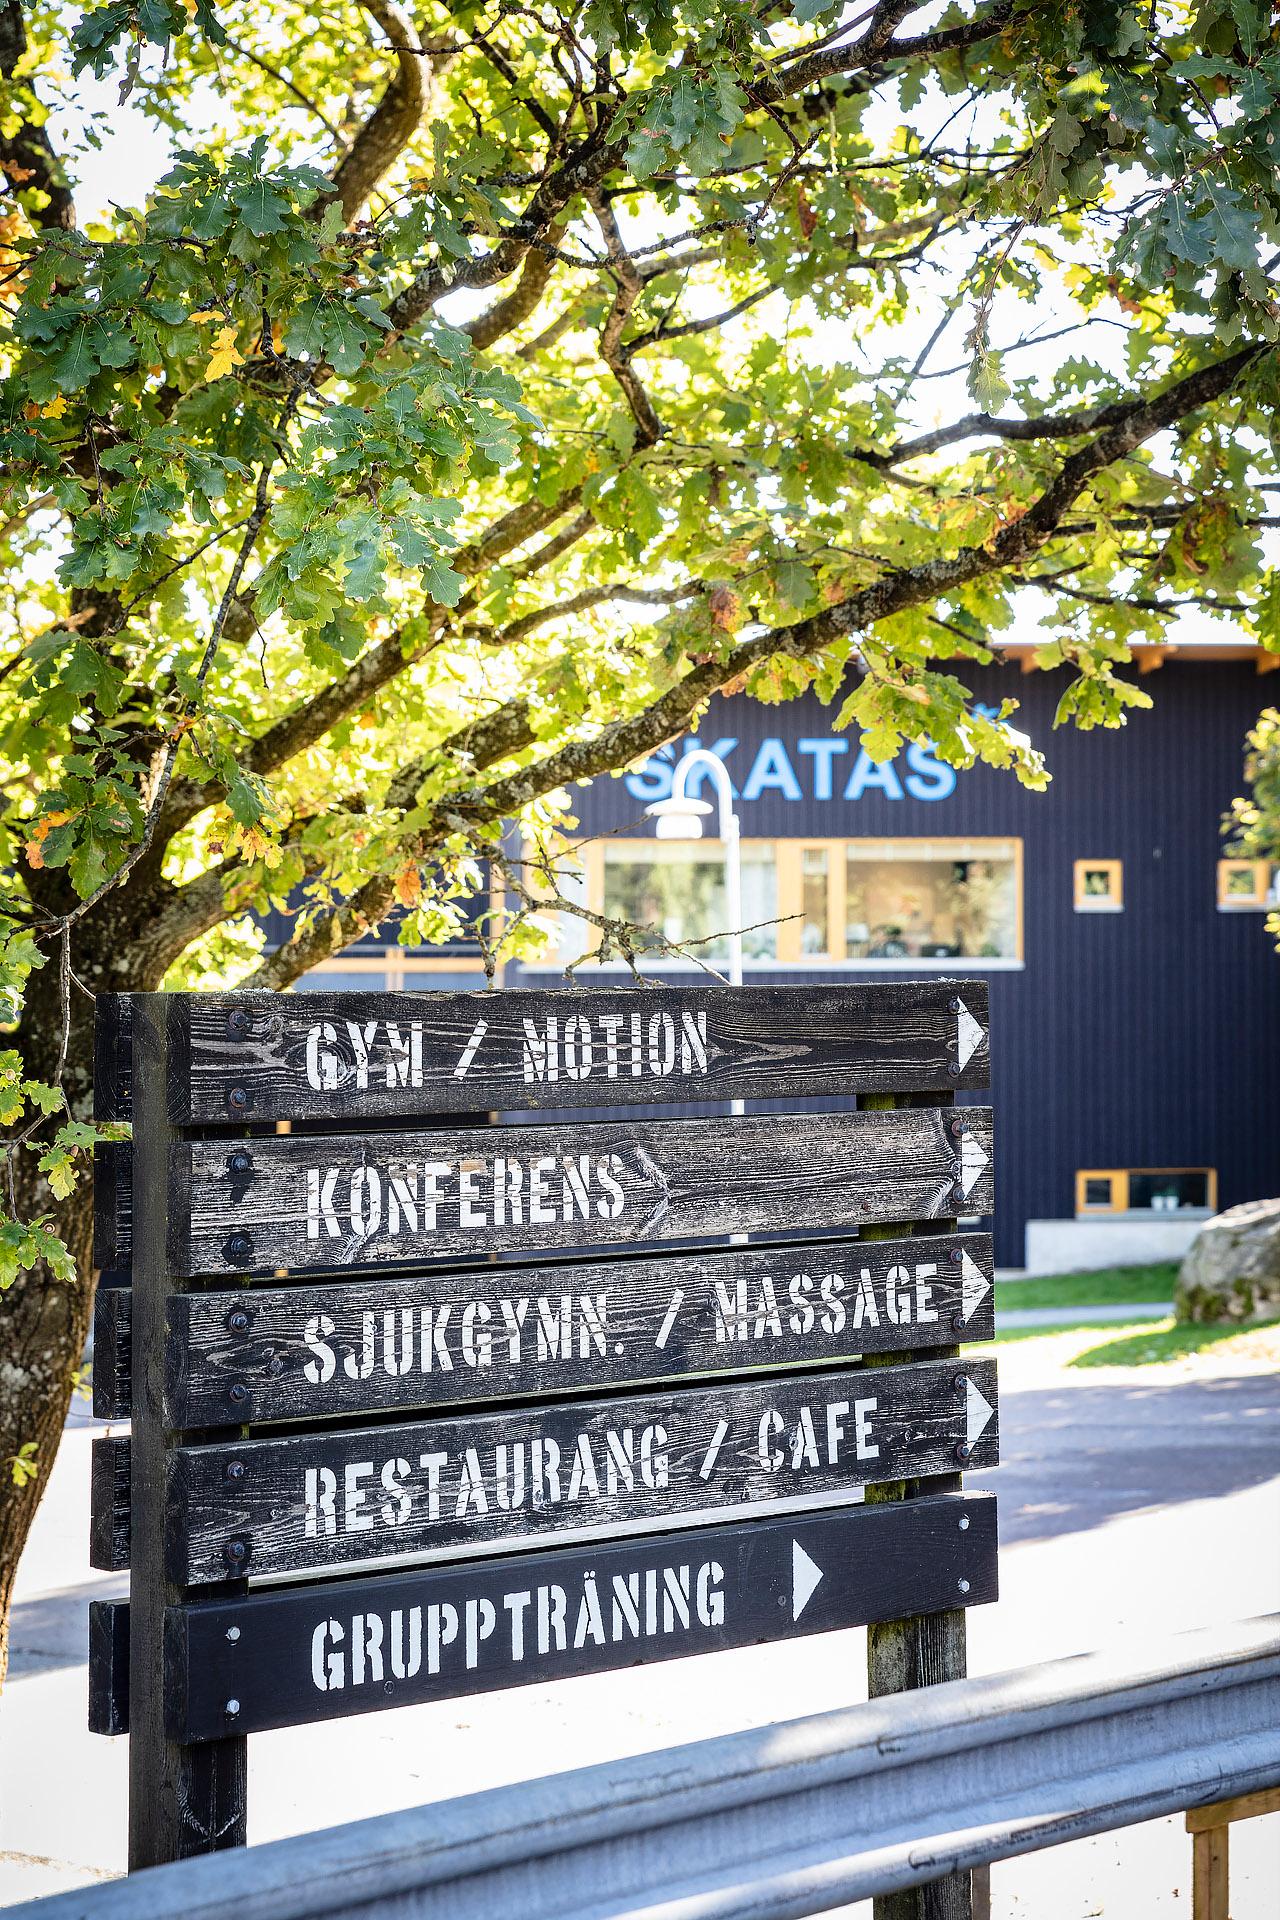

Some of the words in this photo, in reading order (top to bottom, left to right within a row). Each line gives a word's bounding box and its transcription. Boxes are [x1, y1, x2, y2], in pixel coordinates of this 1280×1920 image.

[306, 1021, 423, 1091] GYM
[453, 1019, 489, 1081] /
[523, 1011, 708, 1084] MOTION
[307, 1153, 625, 1239] KONFERENS
[303, 1294, 625, 1384] SJUKGYMN.
[654, 1288, 684, 1349] /
[715, 1263, 939, 1343] MASSAGE
[304, 1424, 669, 1537] RESTAURANG
[699, 1419, 729, 1481] /
[758, 1397, 881, 1473] CAFE
[311, 1561, 726, 1692] GRUPPTRÄNING
